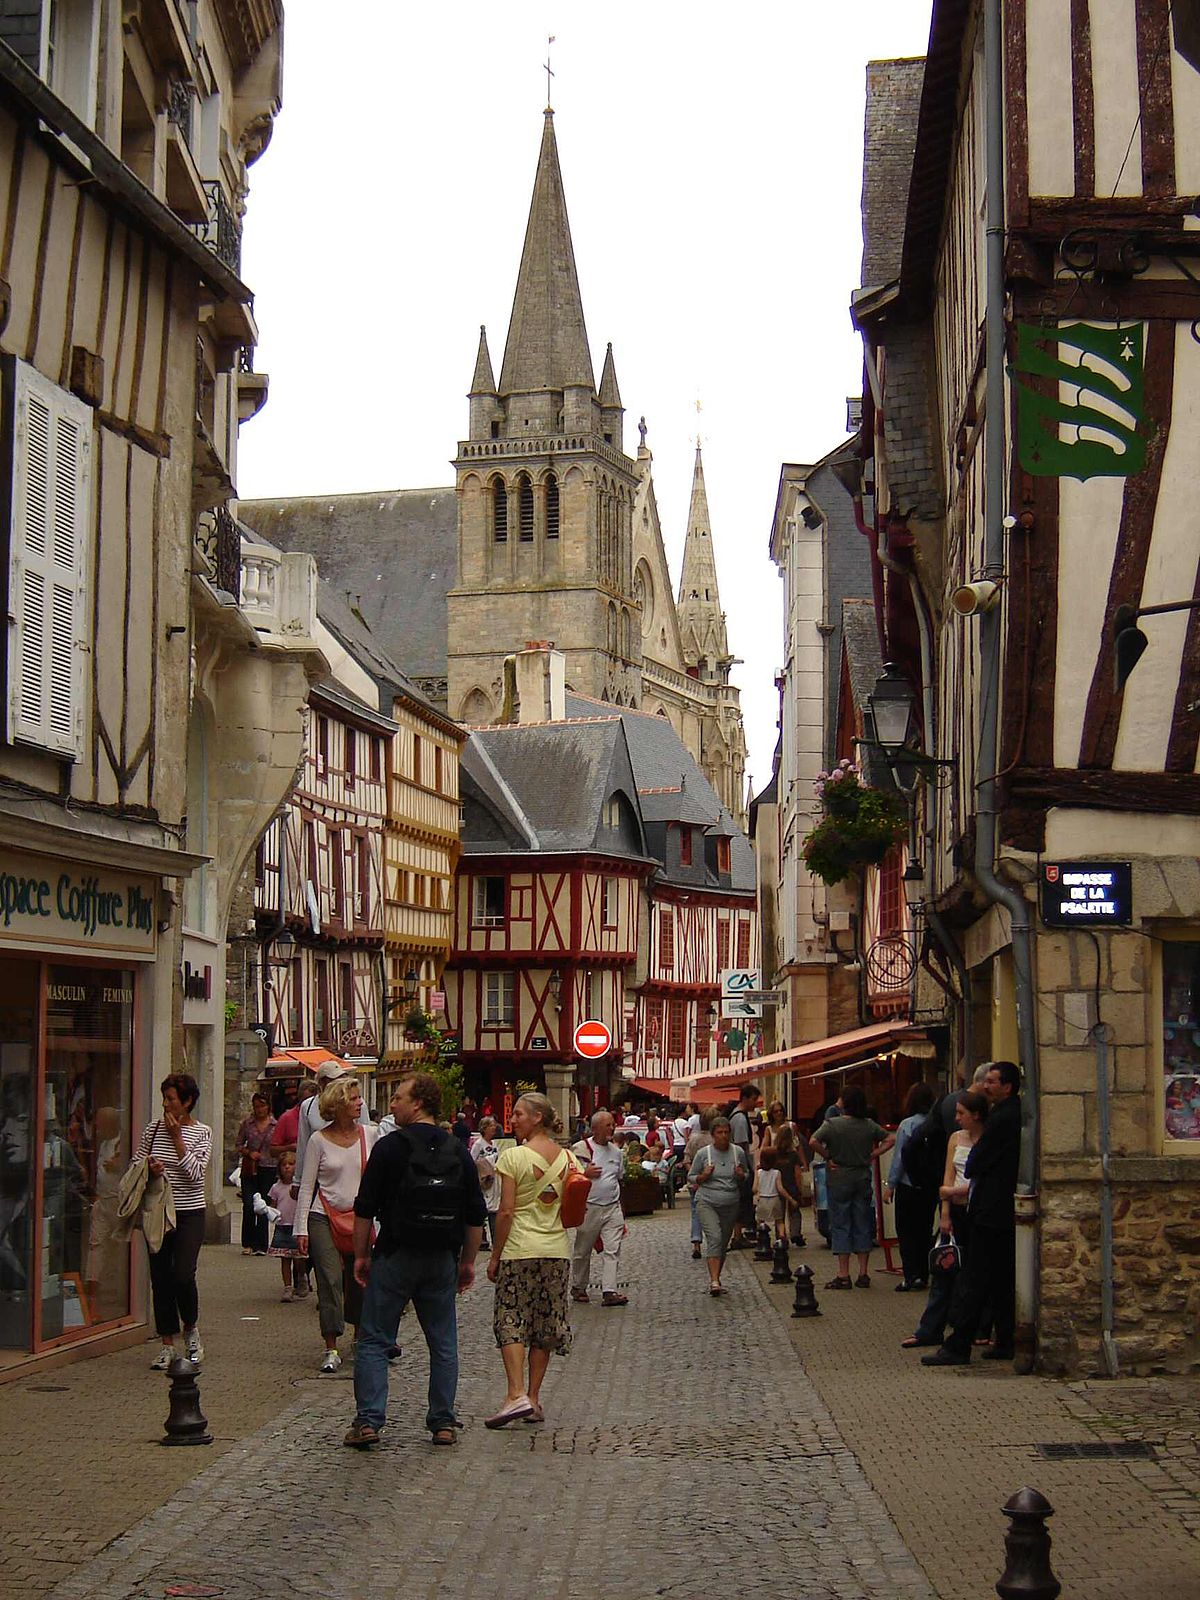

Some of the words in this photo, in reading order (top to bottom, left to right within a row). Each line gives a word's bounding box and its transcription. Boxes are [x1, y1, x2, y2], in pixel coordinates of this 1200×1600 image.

[1062, 873, 1113, 886] IMPASSE
[1070, 887, 1087, 900] DE
[1088, 887, 1105, 900] LA
[57, 874, 123, 937] Coiffure
[1060, 902, 1115, 914] PSALETTE
[47, 984, 87, 1001] MASCULIN
[103, 987, 133, 1003] FEMININ
[341, 1030, 359, 1045] PETIT
[361, 1031, 375, 1044] BOY
